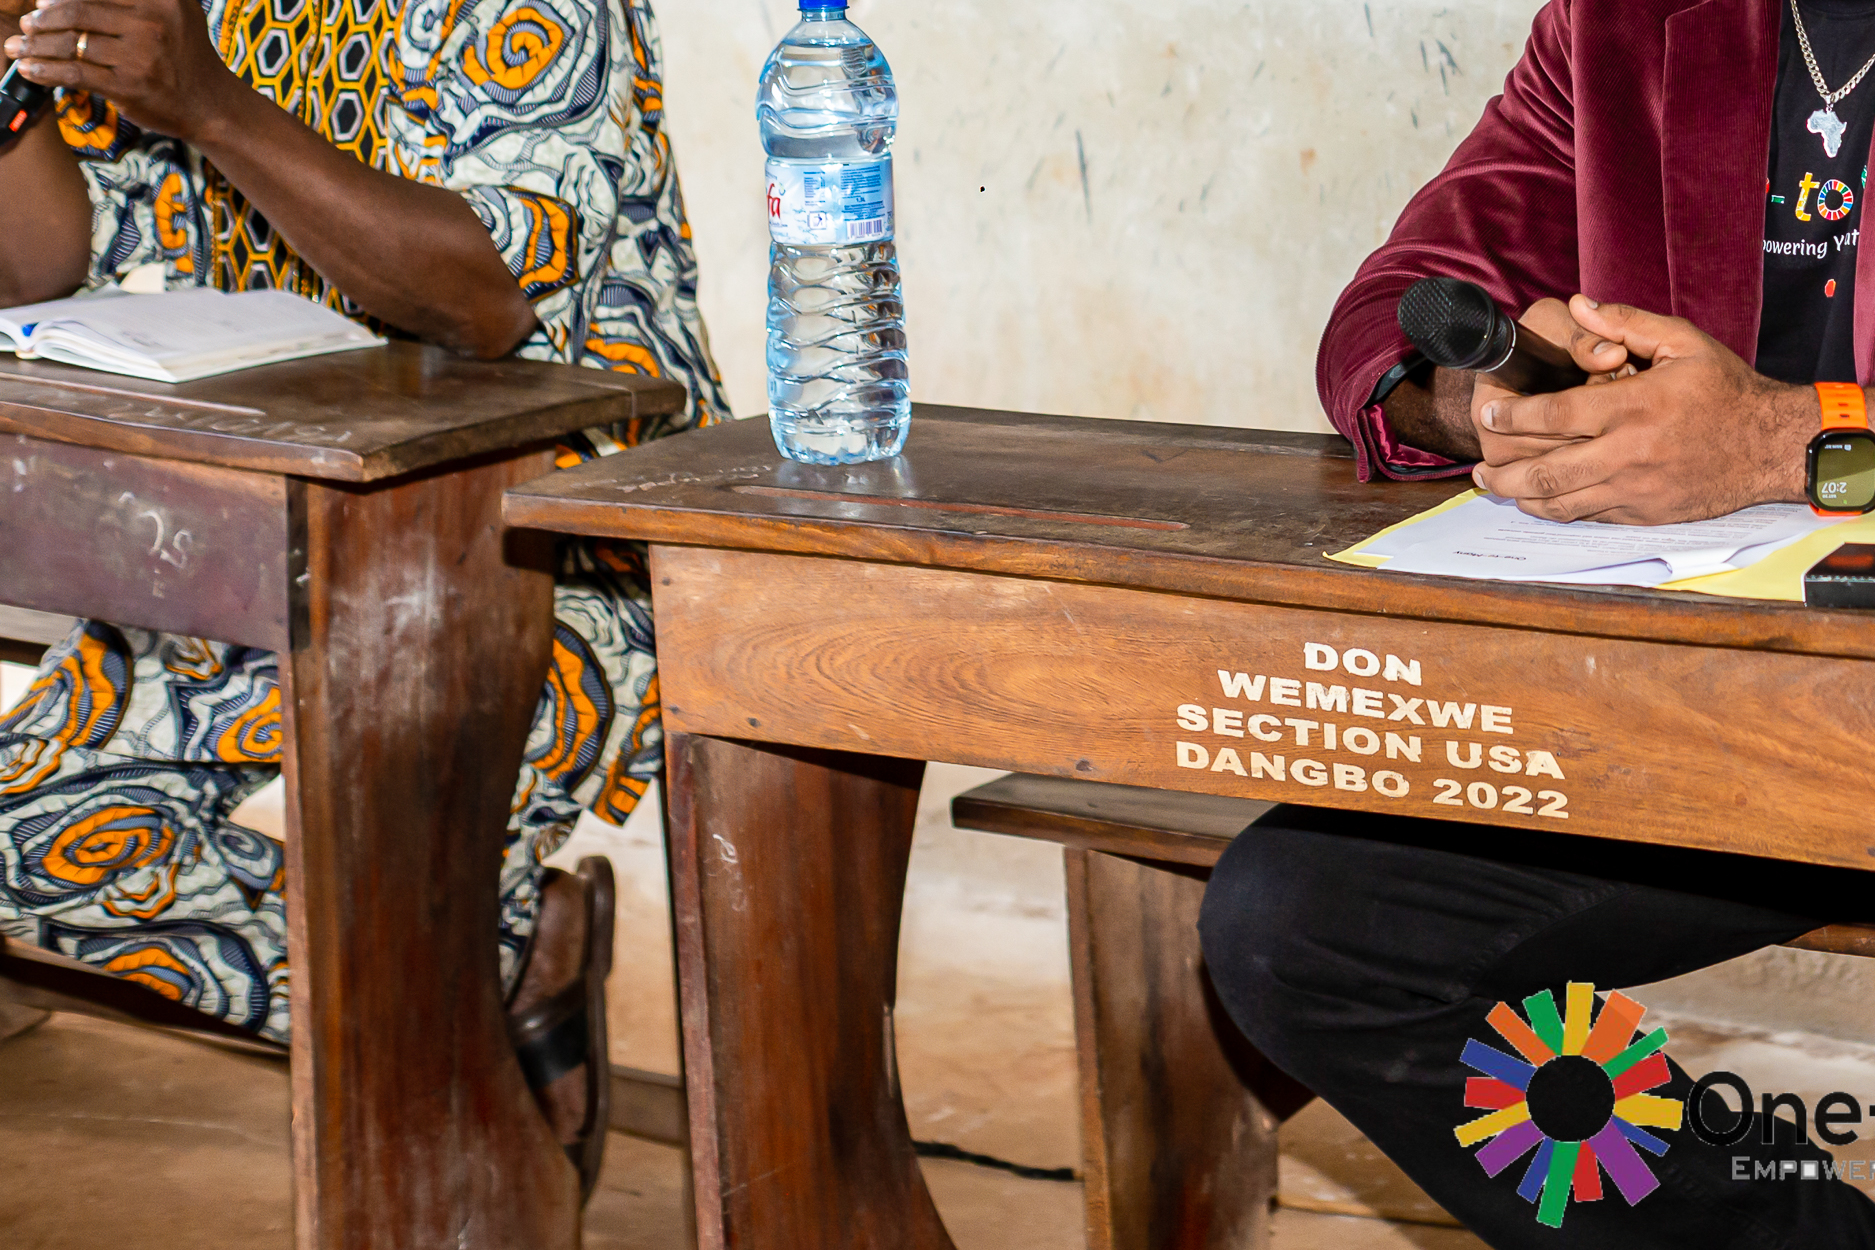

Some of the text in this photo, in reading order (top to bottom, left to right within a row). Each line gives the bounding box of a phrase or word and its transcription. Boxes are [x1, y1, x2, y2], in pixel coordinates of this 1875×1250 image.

[1821, 481, 1848, 494] 2:07
[1303, 641, 1423, 686] DON
[1216, 669, 1514, 735] WEMEXWE
[1175, 703, 1566, 780] SECTION USA
[1175, 741, 1570, 819] DANGBO 2022
